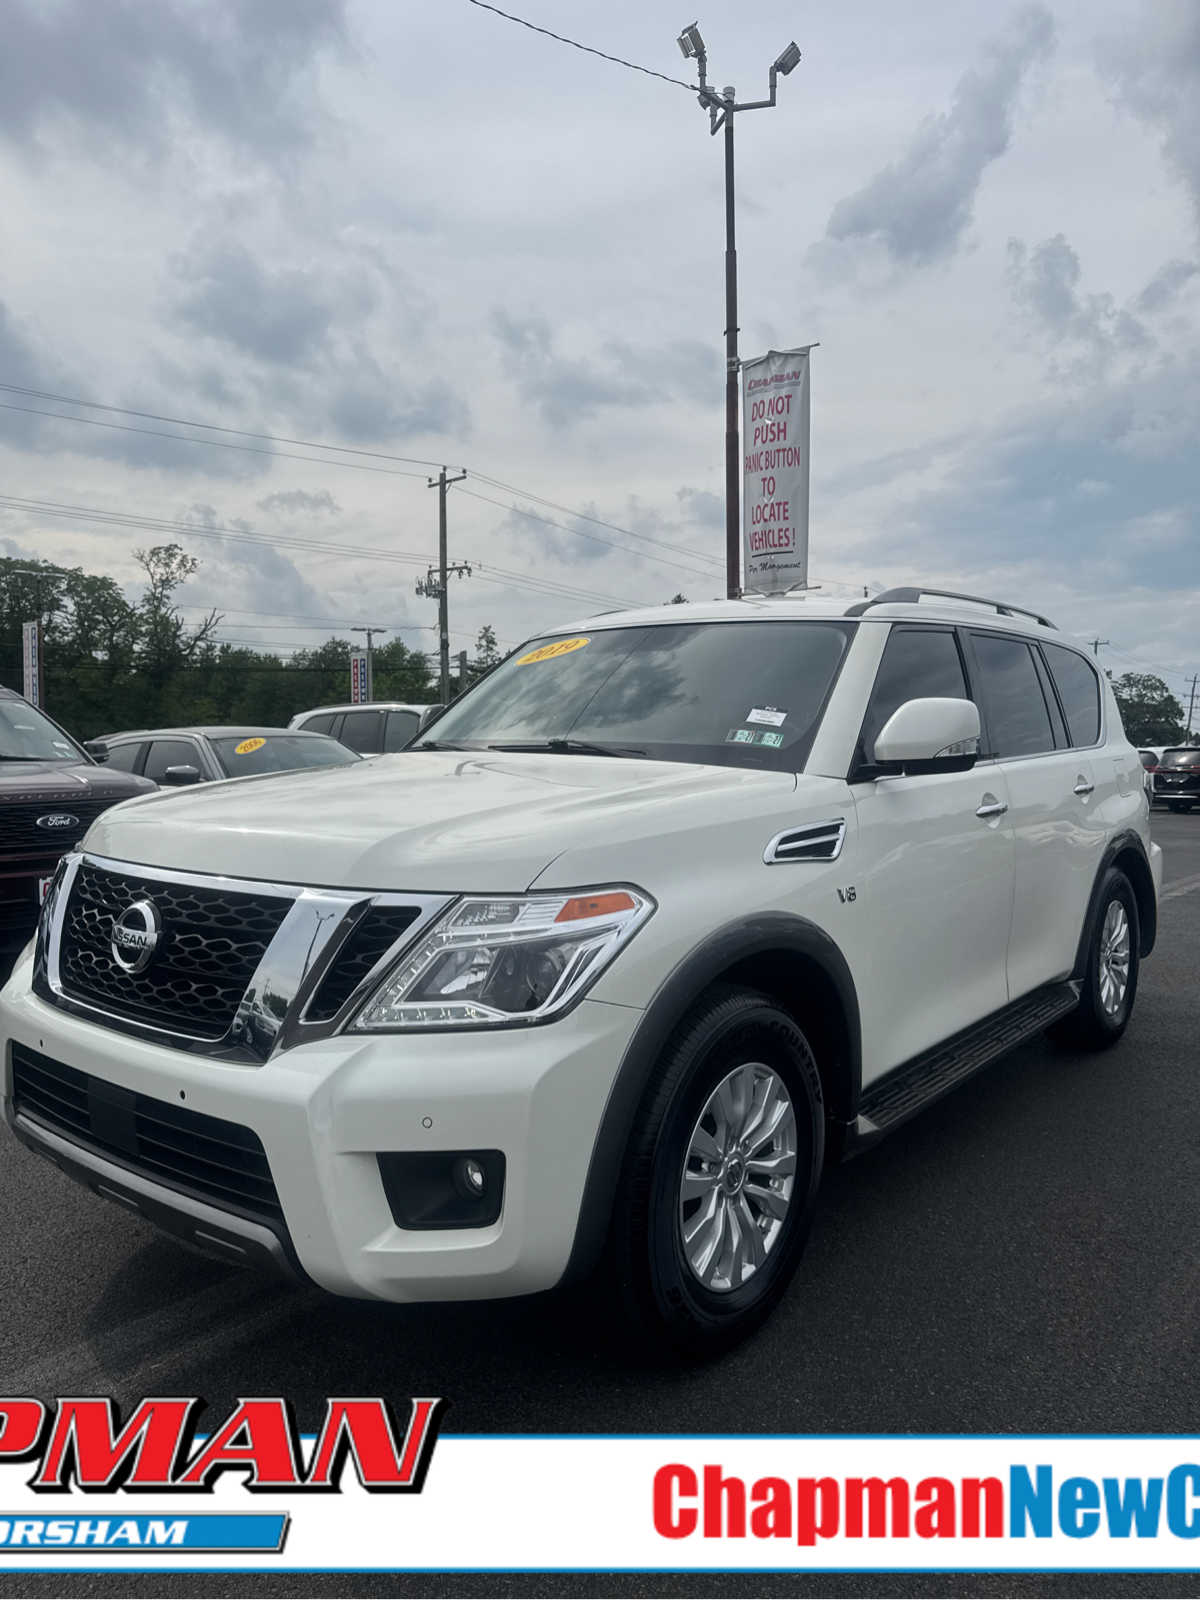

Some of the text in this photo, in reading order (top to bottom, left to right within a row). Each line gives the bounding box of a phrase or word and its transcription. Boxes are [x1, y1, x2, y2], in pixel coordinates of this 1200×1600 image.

[751, 393, 793, 422] DO NOT
[753, 421, 788, 447] PUSH
[745, 446, 801, 473] PANIC BUTTON
[760, 476, 776, 498] TO
[751, 501, 790, 525] LOCATE
[47, 815, 71, 826] Ford
[836, 886, 857, 904] V8
